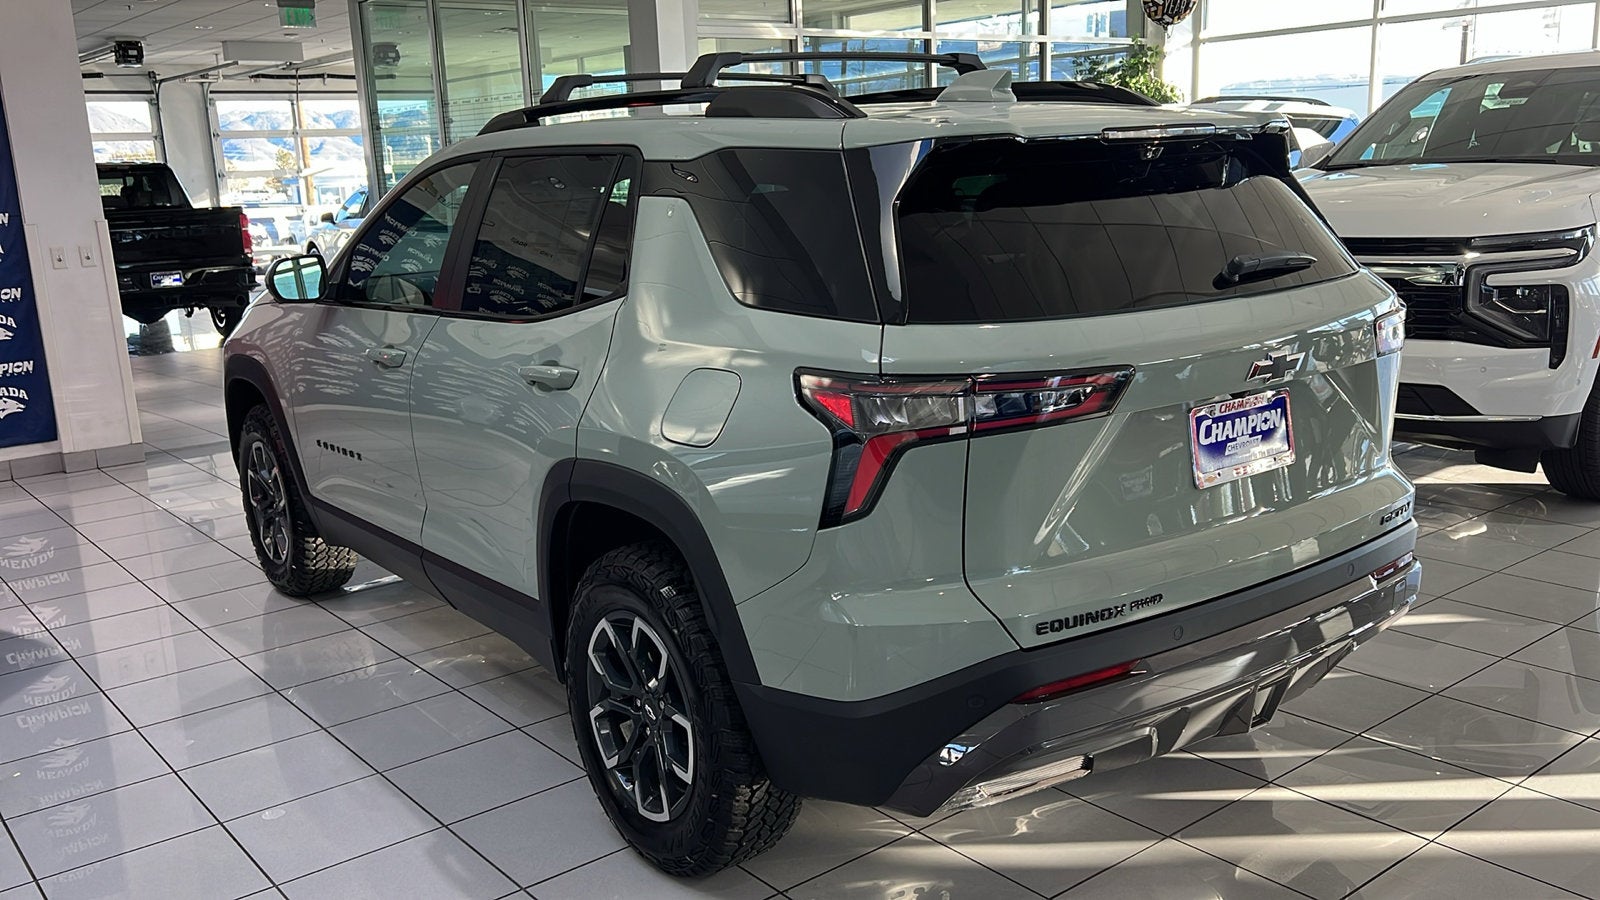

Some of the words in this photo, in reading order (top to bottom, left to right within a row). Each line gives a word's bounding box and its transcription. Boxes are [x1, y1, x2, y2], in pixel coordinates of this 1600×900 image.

[1218, 395, 1265, 414] CHAMPION
[1199, 408, 1282, 445] CHAMPION
[315, 439, 363, 461] EQUINOX
[1227, 437, 1260, 452] CHEVROLET
[1035, 603, 1127, 636] EQUINOX
